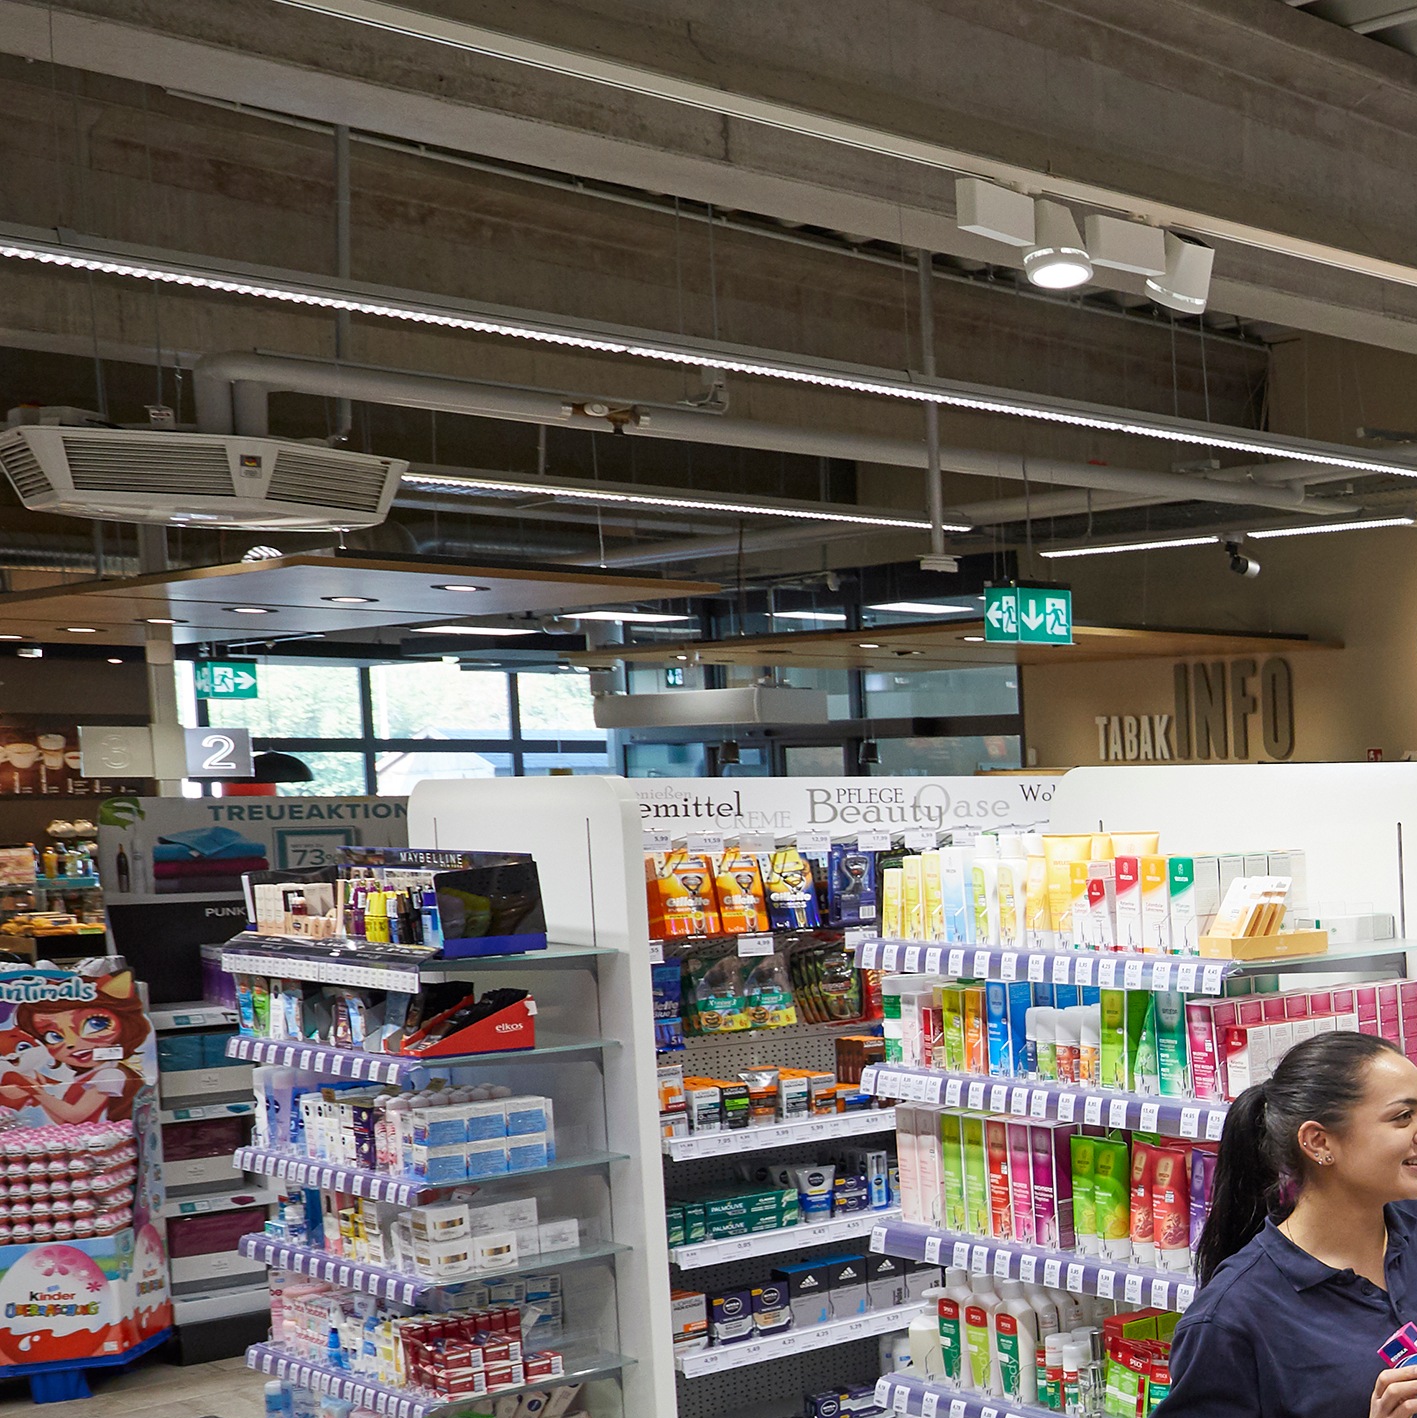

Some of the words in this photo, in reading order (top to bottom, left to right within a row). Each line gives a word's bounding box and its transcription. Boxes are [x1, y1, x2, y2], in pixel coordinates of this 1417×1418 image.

[1095, 714, 1173, 762] TABAK
[1173, 657, 1296, 761] INFO
[201, 735, 236, 769] 2
[837, 788, 904, 804] PFLEGE
[807, 787, 944, 830] Beauty
[915, 783, 1010, 819] Oase
[401, 852, 462, 864] MAYBELLINE
[770, 892, 812, 901] Gillette
[711, 1203, 743, 1212] PALMOLIVE
